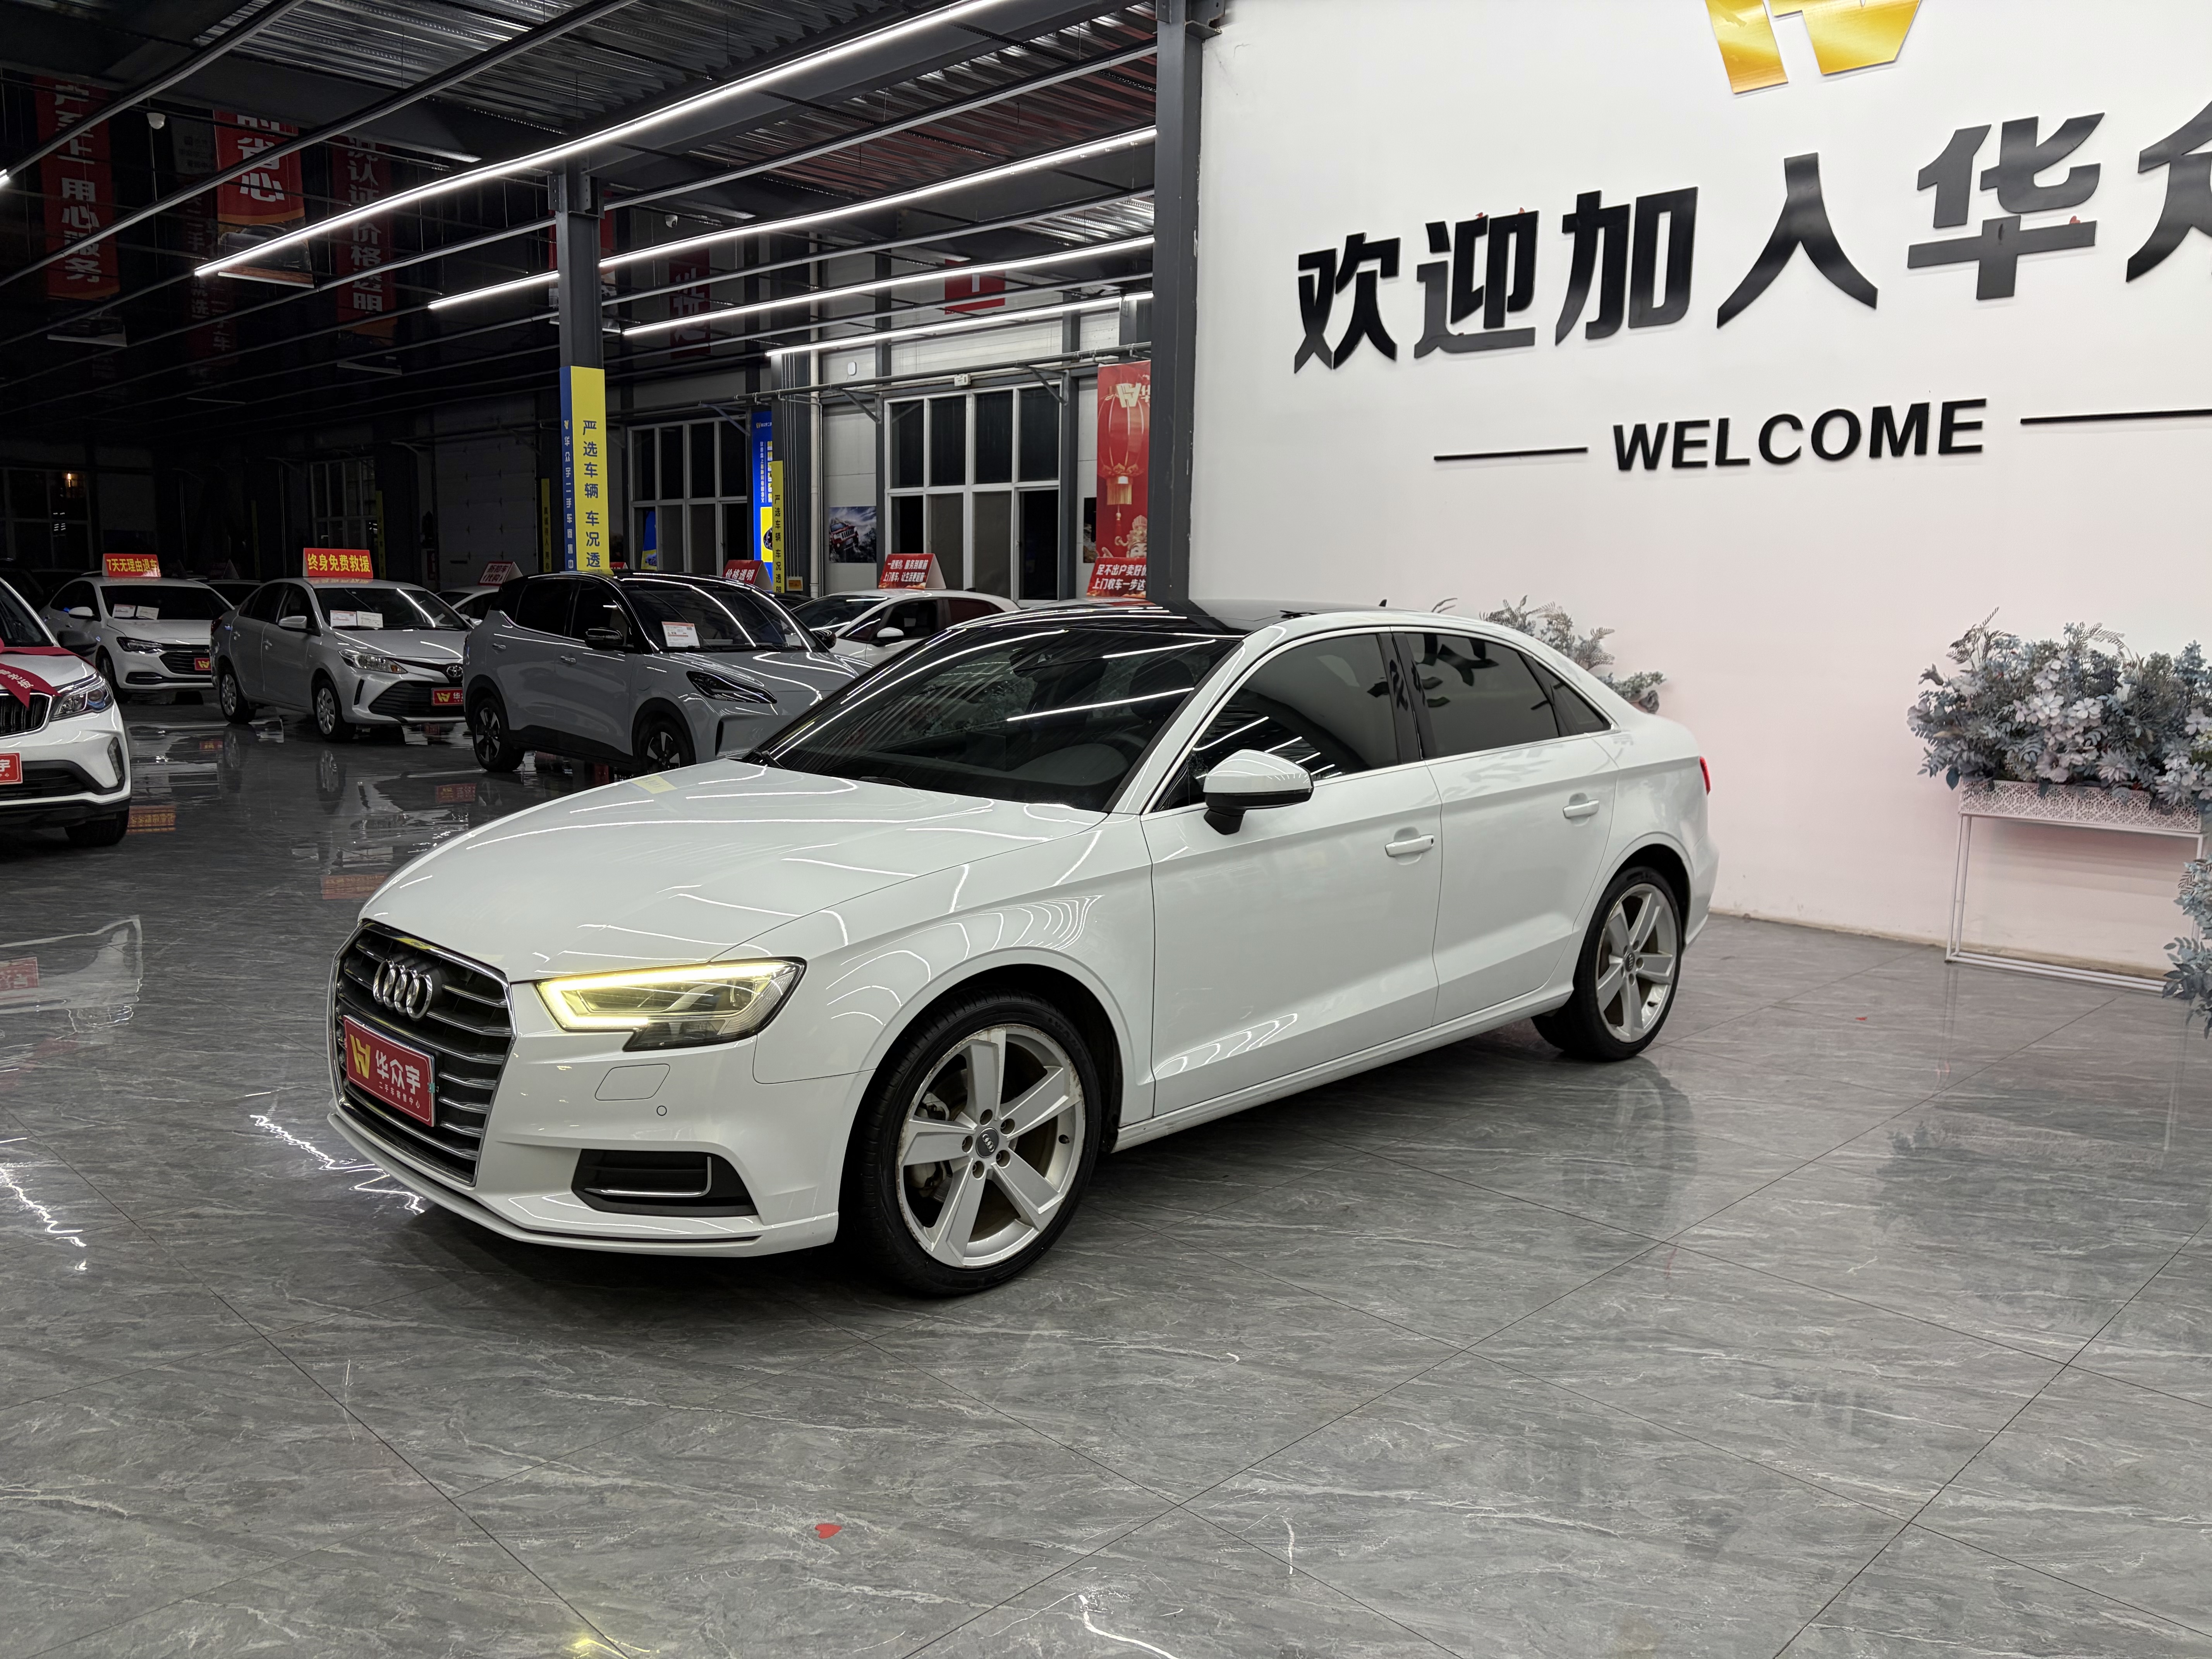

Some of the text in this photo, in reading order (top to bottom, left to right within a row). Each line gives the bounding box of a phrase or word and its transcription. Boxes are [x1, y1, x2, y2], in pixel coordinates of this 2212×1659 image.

[1614, 398, 1986, 471] WELCOME
[583, 420, 598, 498] 严选车辆
[106, 558, 157, 572] 7天无理由退车
[307, 553, 371, 572] 终身免费救援
[725, 569, 755, 581] 价格透明
[375, 1049, 421, 1095] 华众宇
